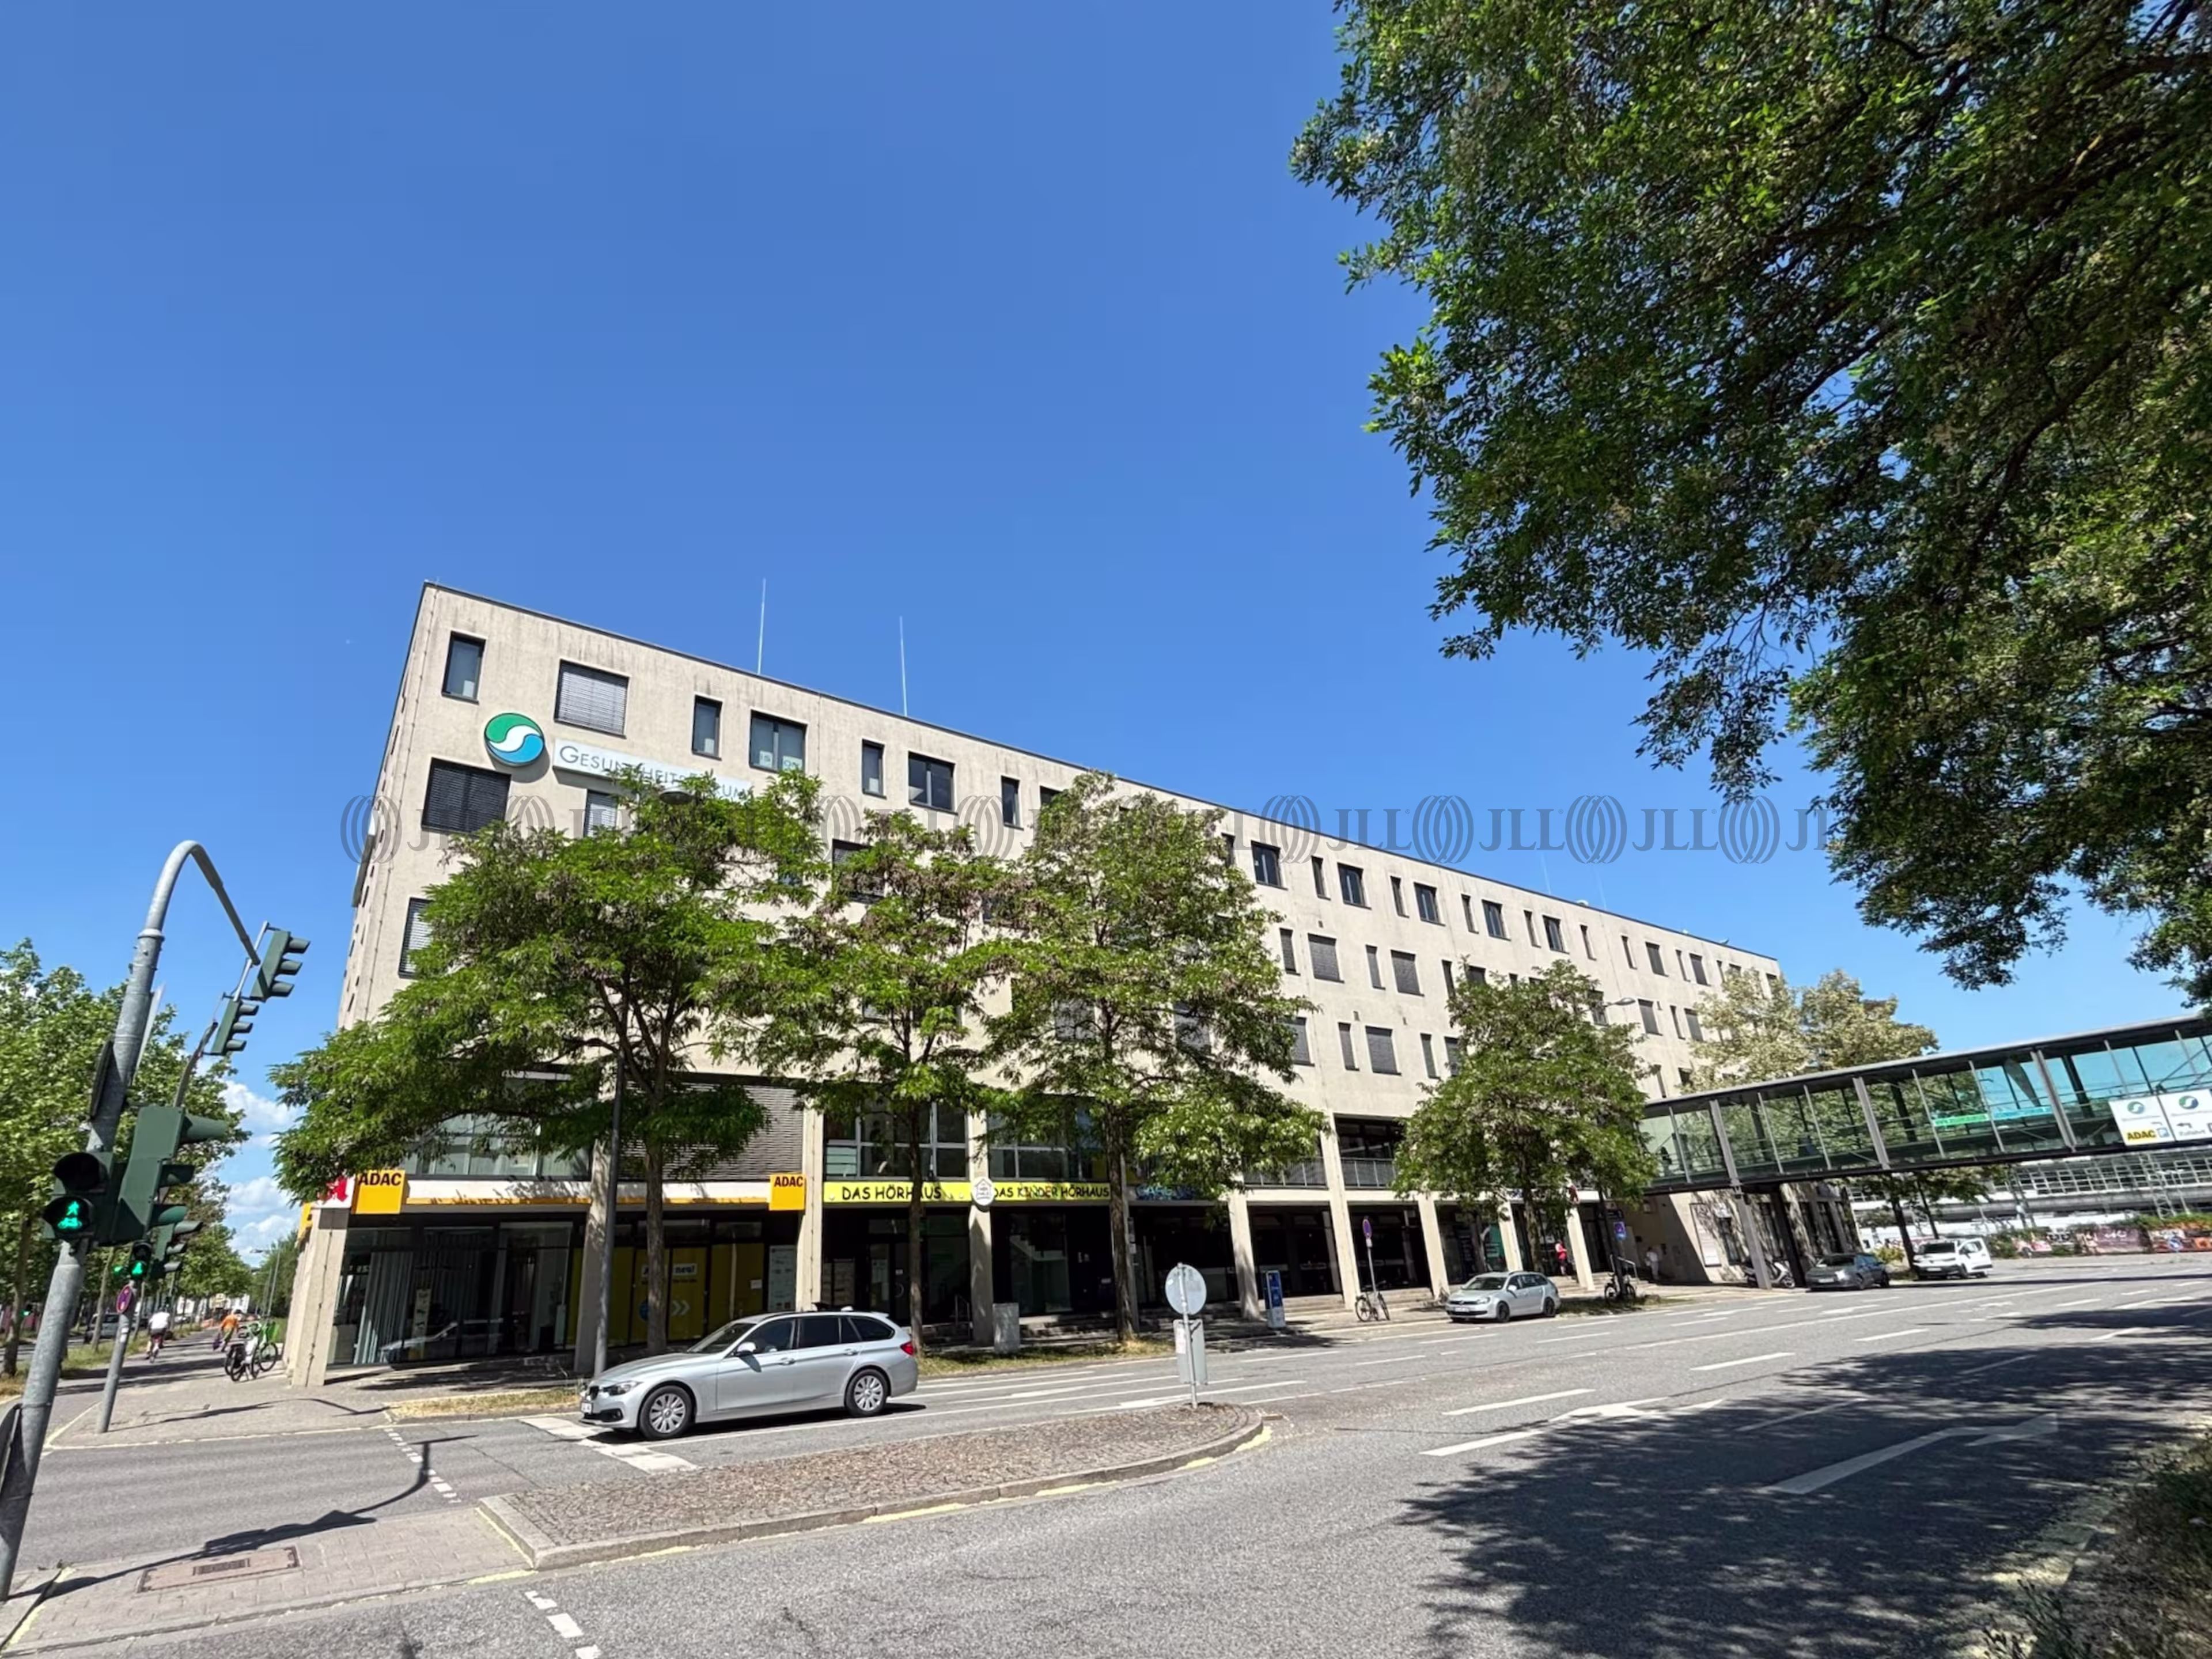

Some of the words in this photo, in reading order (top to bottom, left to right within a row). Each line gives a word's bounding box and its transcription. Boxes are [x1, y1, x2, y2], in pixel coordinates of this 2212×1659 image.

[2127, 1130, 2156, 1140] ADAC
[358, 1172, 402, 1186] ADAC
[774, 1176, 804, 1187] ADAC
[842, 1186, 870, 1200] DAS
[875, 1184, 942, 1200] HÖRHUS
[1017, 1184, 1058, 1198] KINDER
[1060, 1184, 1109, 1198] HÖRHAUS
